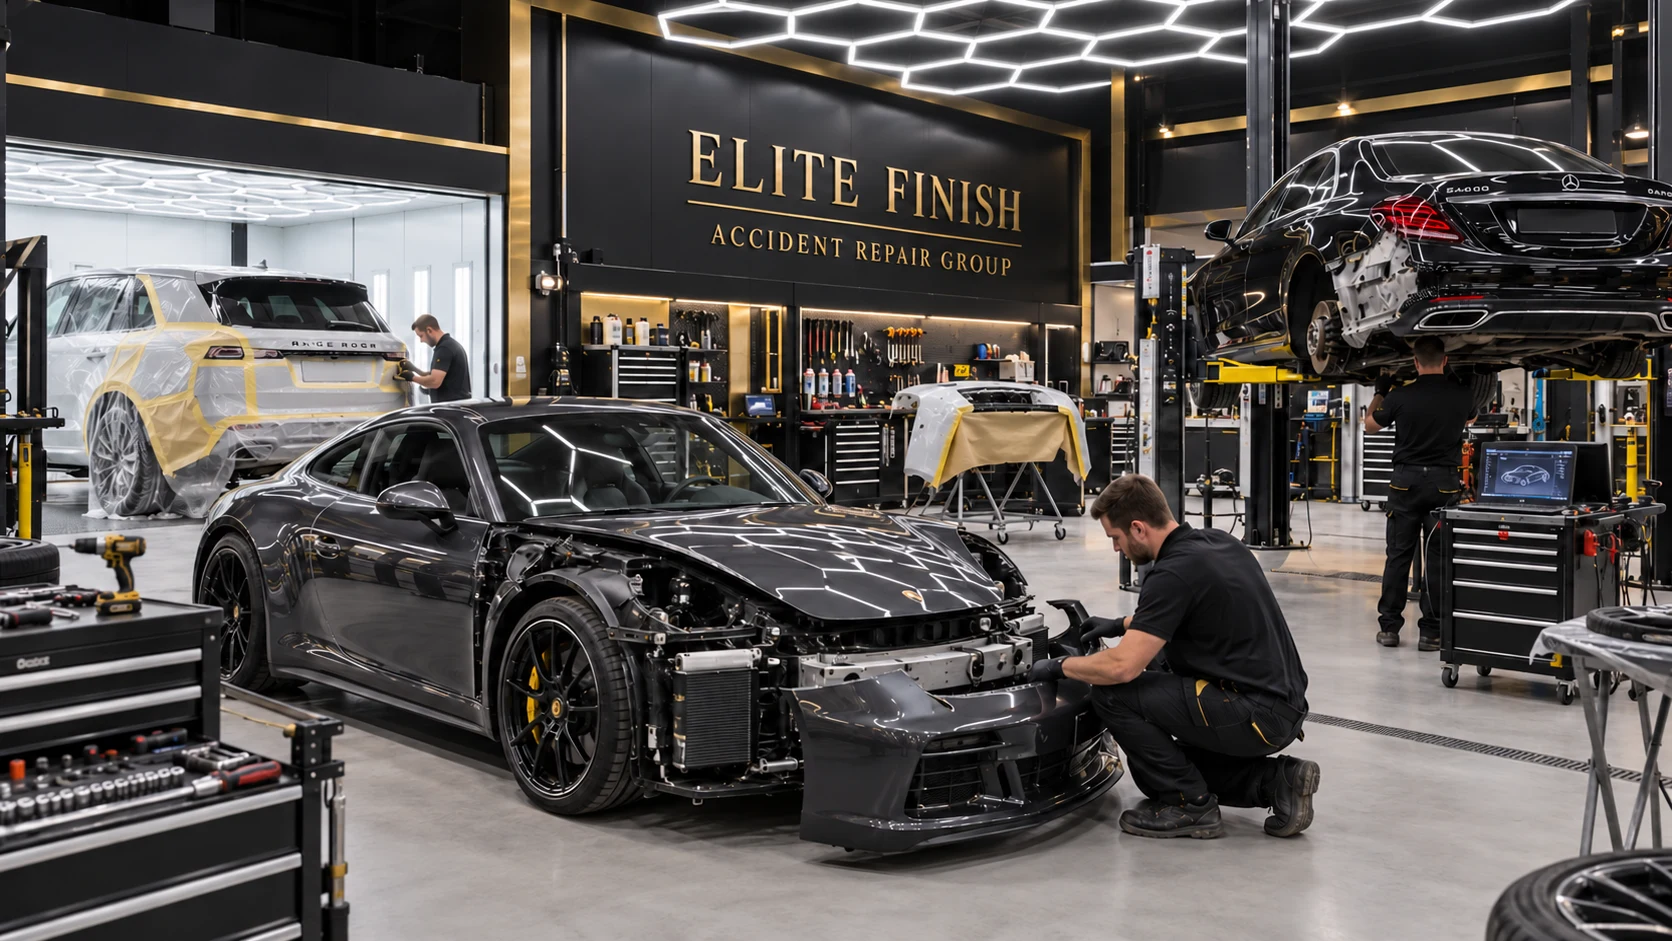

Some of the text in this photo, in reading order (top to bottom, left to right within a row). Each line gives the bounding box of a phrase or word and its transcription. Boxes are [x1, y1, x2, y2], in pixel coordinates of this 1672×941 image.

[688, 129, 1021, 232] ELITE FINISH
[711, 223, 1011, 276] ACCIDENT REPAIR GROUP
